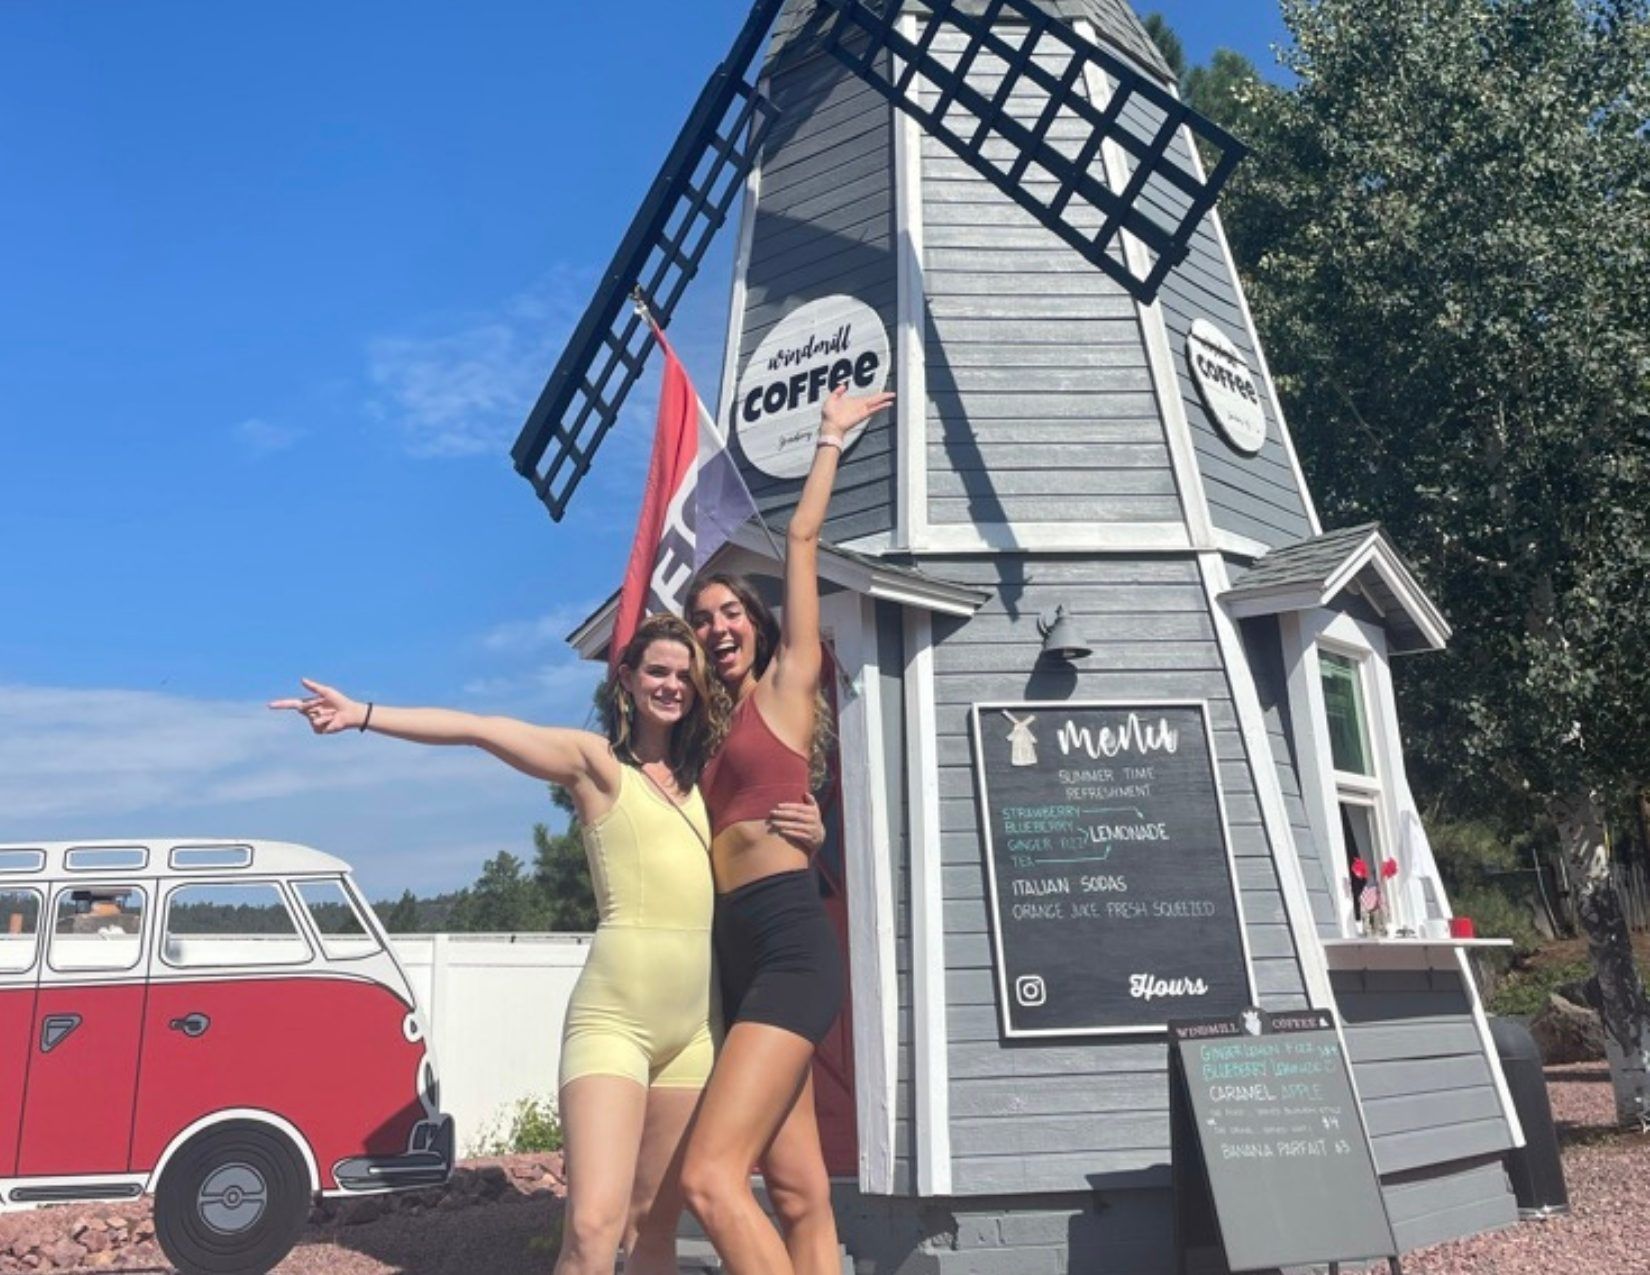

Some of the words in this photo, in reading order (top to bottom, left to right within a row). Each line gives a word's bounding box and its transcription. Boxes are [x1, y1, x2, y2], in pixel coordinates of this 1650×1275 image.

[768, 323, 851, 370] windmill
[1059, 768, 1114, 785] SUMMER
[1122, 767, 1155, 781] TIME
[1002, 805, 1080, 820] STRAWBERRY
[1004, 820, 1073, 834] BLUEBERRY
[1088, 823, 1170, 843] LEMONADE
[1012, 877, 1070, 896] ITALIAN
[1080, 875, 1128, 893] SODAS
[1012, 903, 1063, 921] ORANGE
[1106, 901, 1148, 919] FRESH
[1152, 901, 1216, 917] SQUEEZED
[1128, 973, 1209, 1001] Hours
[1209, 1084, 1278, 1102] CARAMEL
[1220, 1142, 1273, 1159] BANANA
